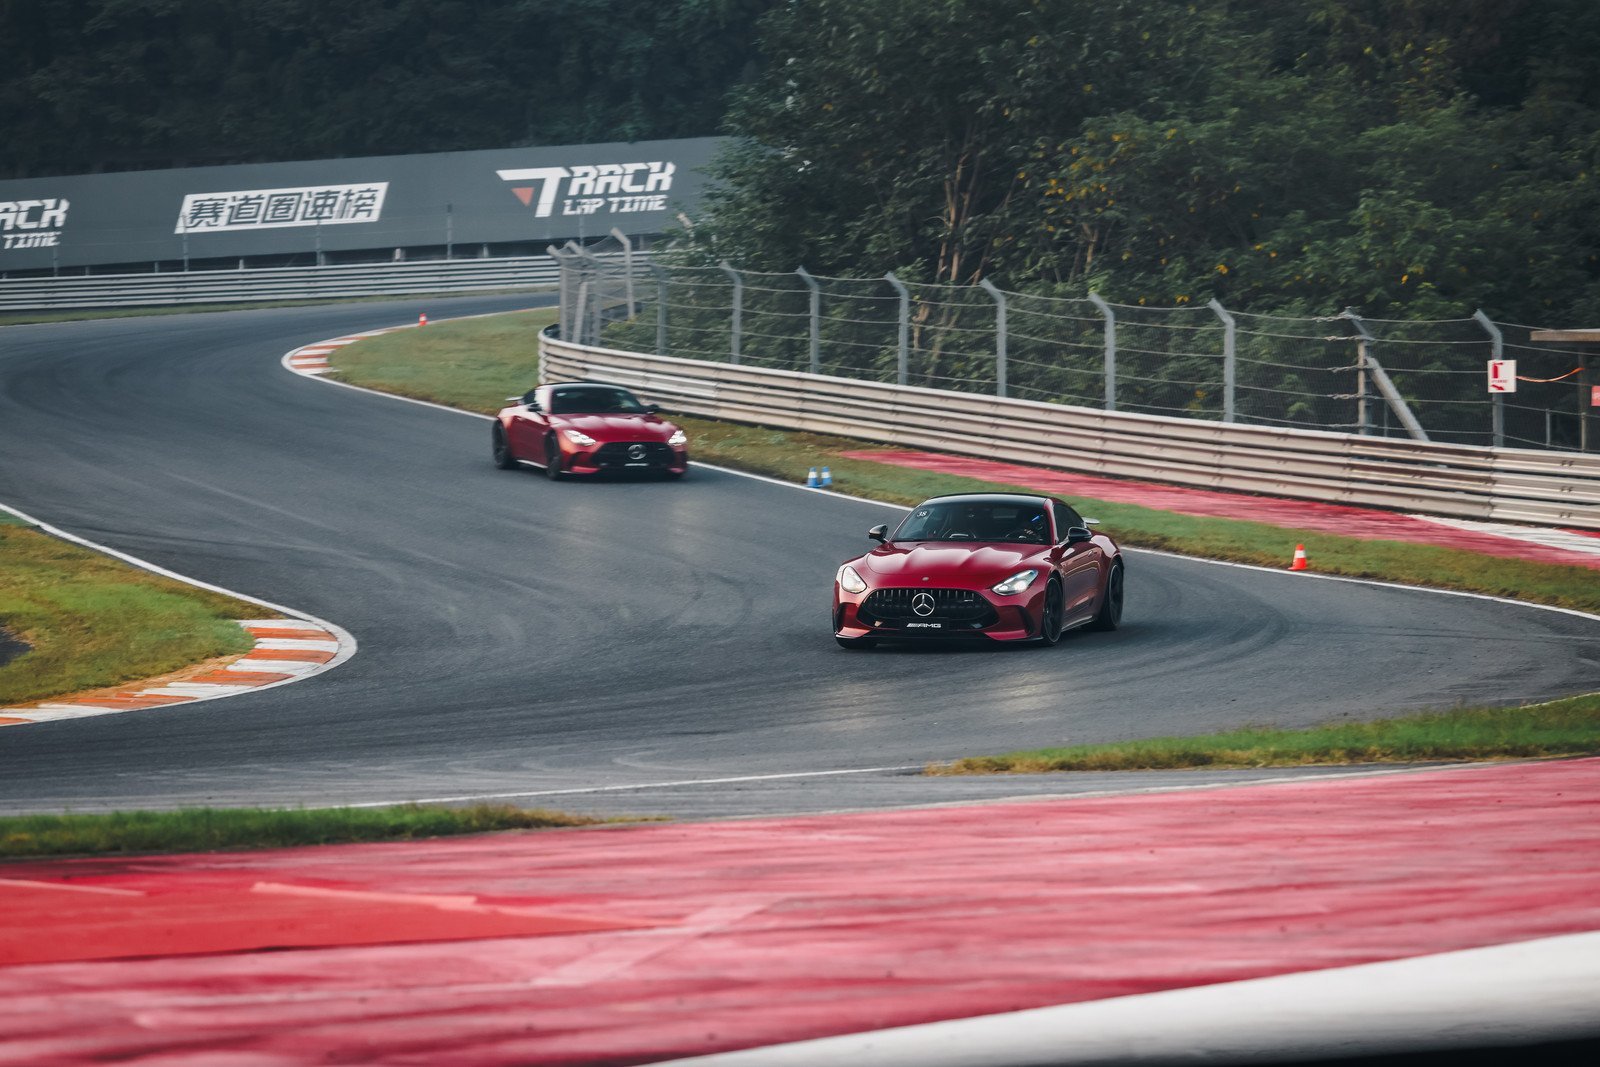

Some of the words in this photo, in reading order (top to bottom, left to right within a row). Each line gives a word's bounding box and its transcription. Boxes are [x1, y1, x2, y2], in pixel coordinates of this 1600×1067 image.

[186, 187, 379, 228] 赛道圈速榜
[562, 199, 605, 216] LAP
[606, 194, 668, 213] TIME
[2, 231, 62, 249] TIME
